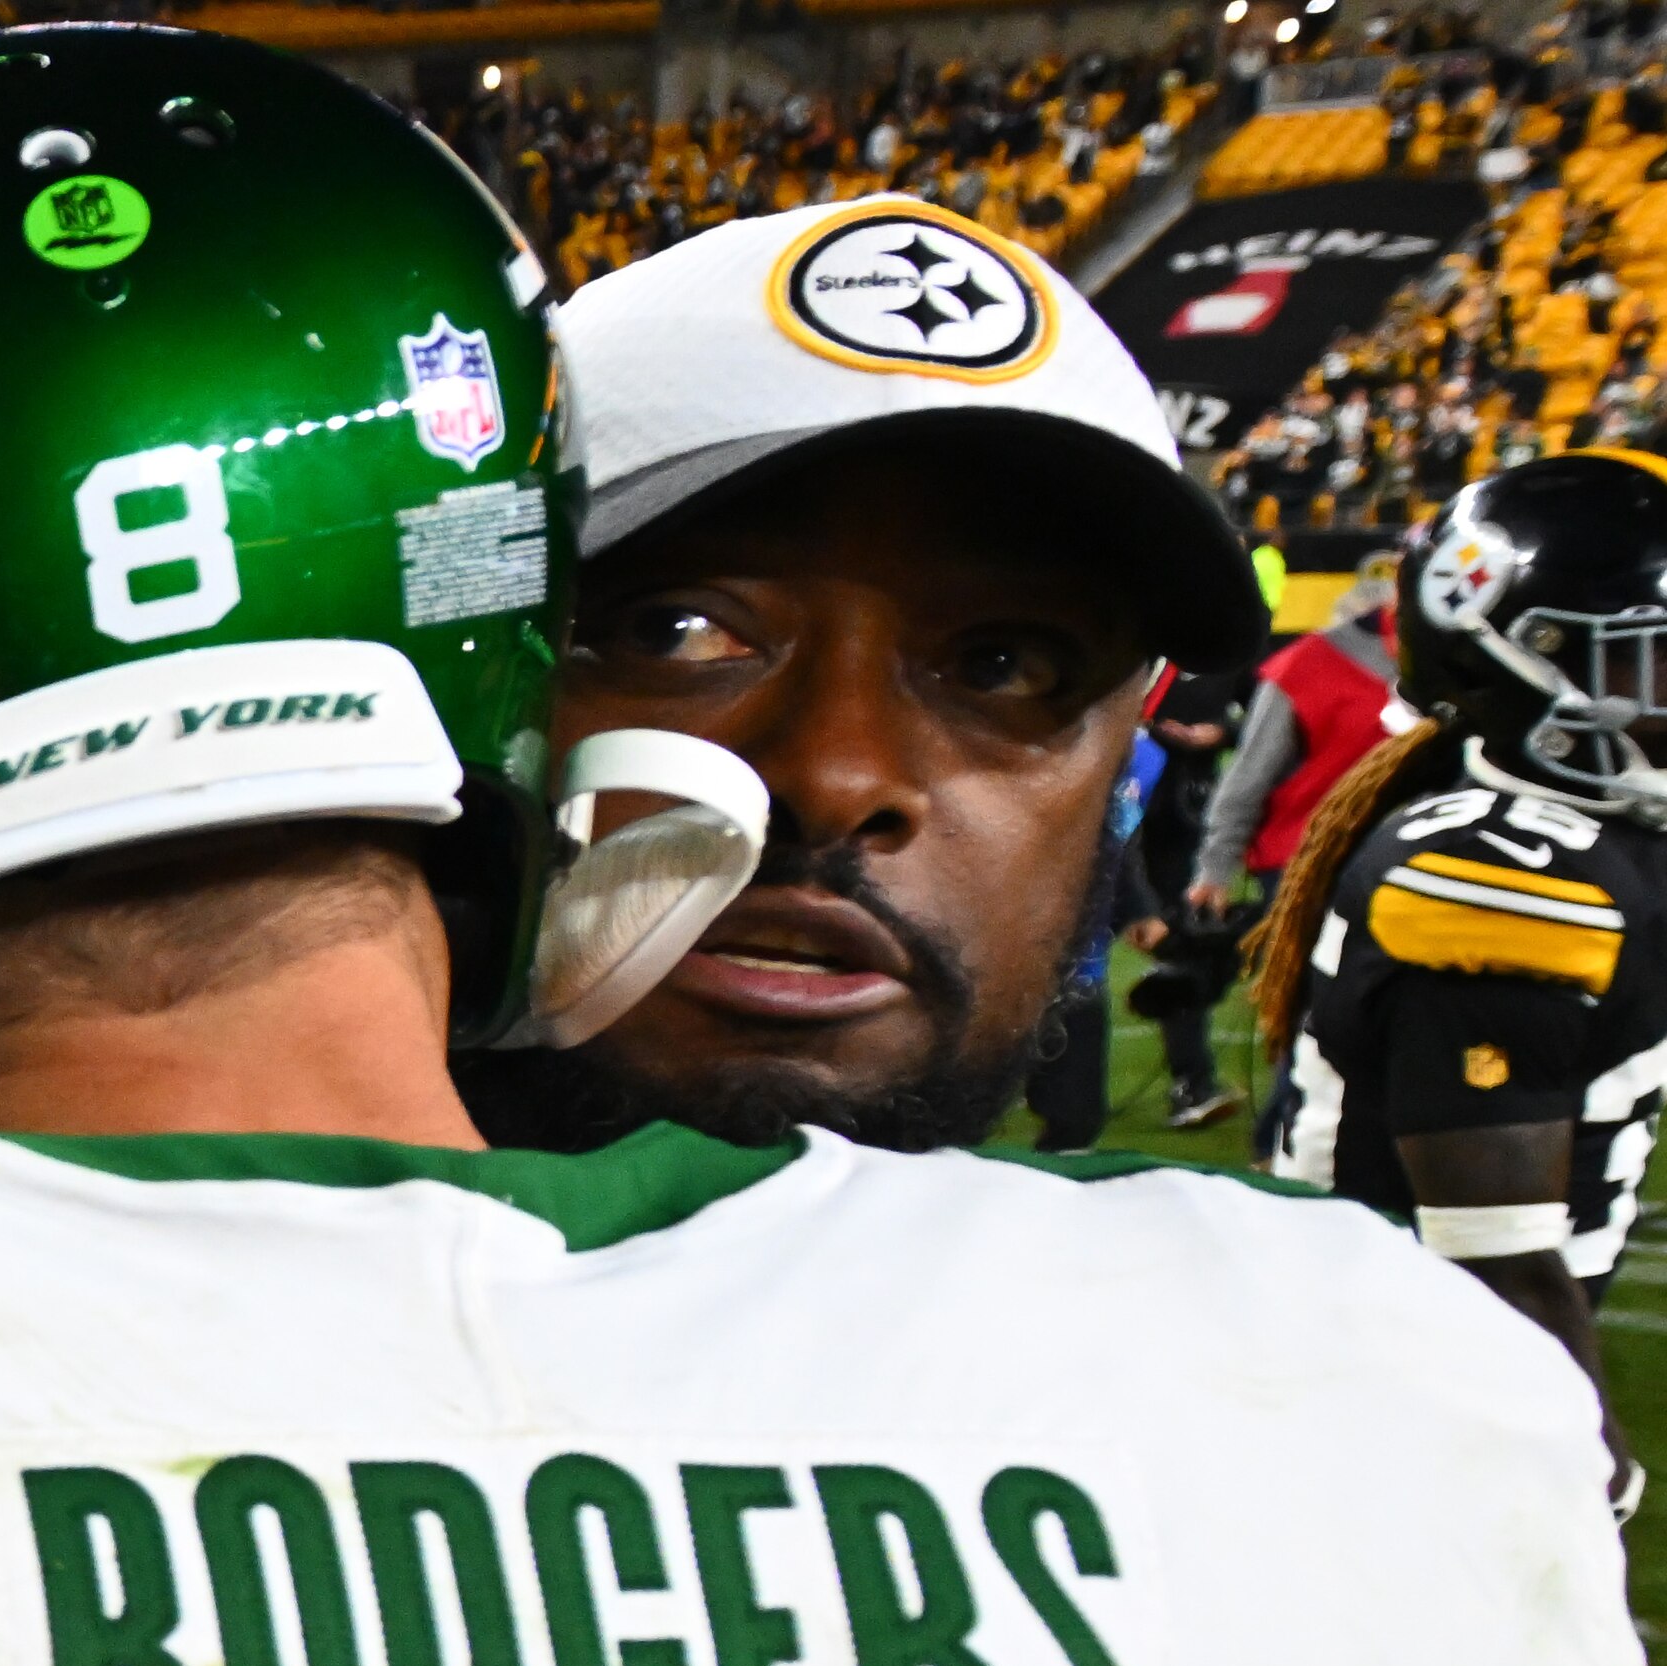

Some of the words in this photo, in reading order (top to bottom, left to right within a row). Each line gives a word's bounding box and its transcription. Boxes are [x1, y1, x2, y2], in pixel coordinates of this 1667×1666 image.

[816, 271, 919, 291] Steelers
[74, 443, 241, 638] 8
[175, 692, 382, 740] YORK
